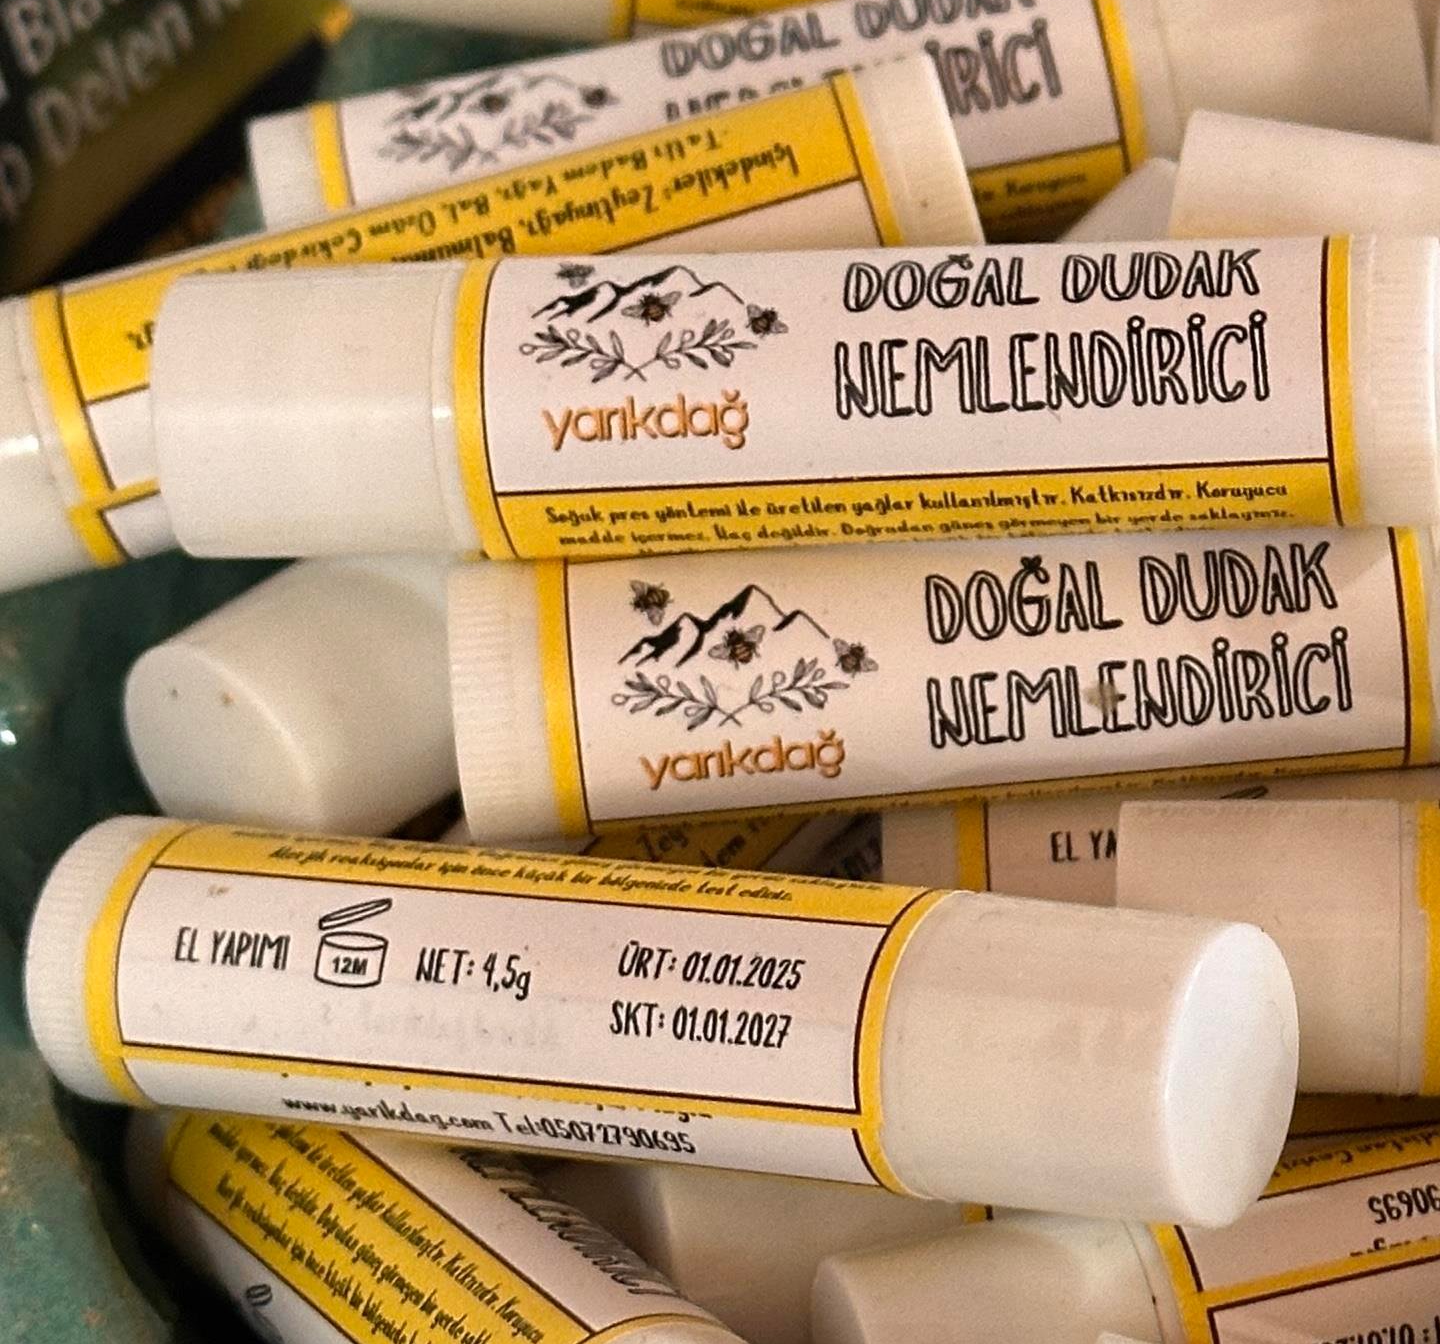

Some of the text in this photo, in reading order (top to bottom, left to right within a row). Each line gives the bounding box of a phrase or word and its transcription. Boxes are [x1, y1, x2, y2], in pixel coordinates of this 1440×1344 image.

[1061, 249, 1261, 304] DUDAK
[834, 309, 1270, 420] NEMLENDİRİCİ
[1139, 541, 1338, 626] DUDAK
[927, 626, 1353, 749] NEMLENDİRİCİ
[174, 927, 531, 1001] EL YAPIMI 12M NET: 4,5g
[618, 940, 806, 990] ÜRT: 01.01.2025
[610, 1000, 792, 1049] SKT: 01.01.2027
